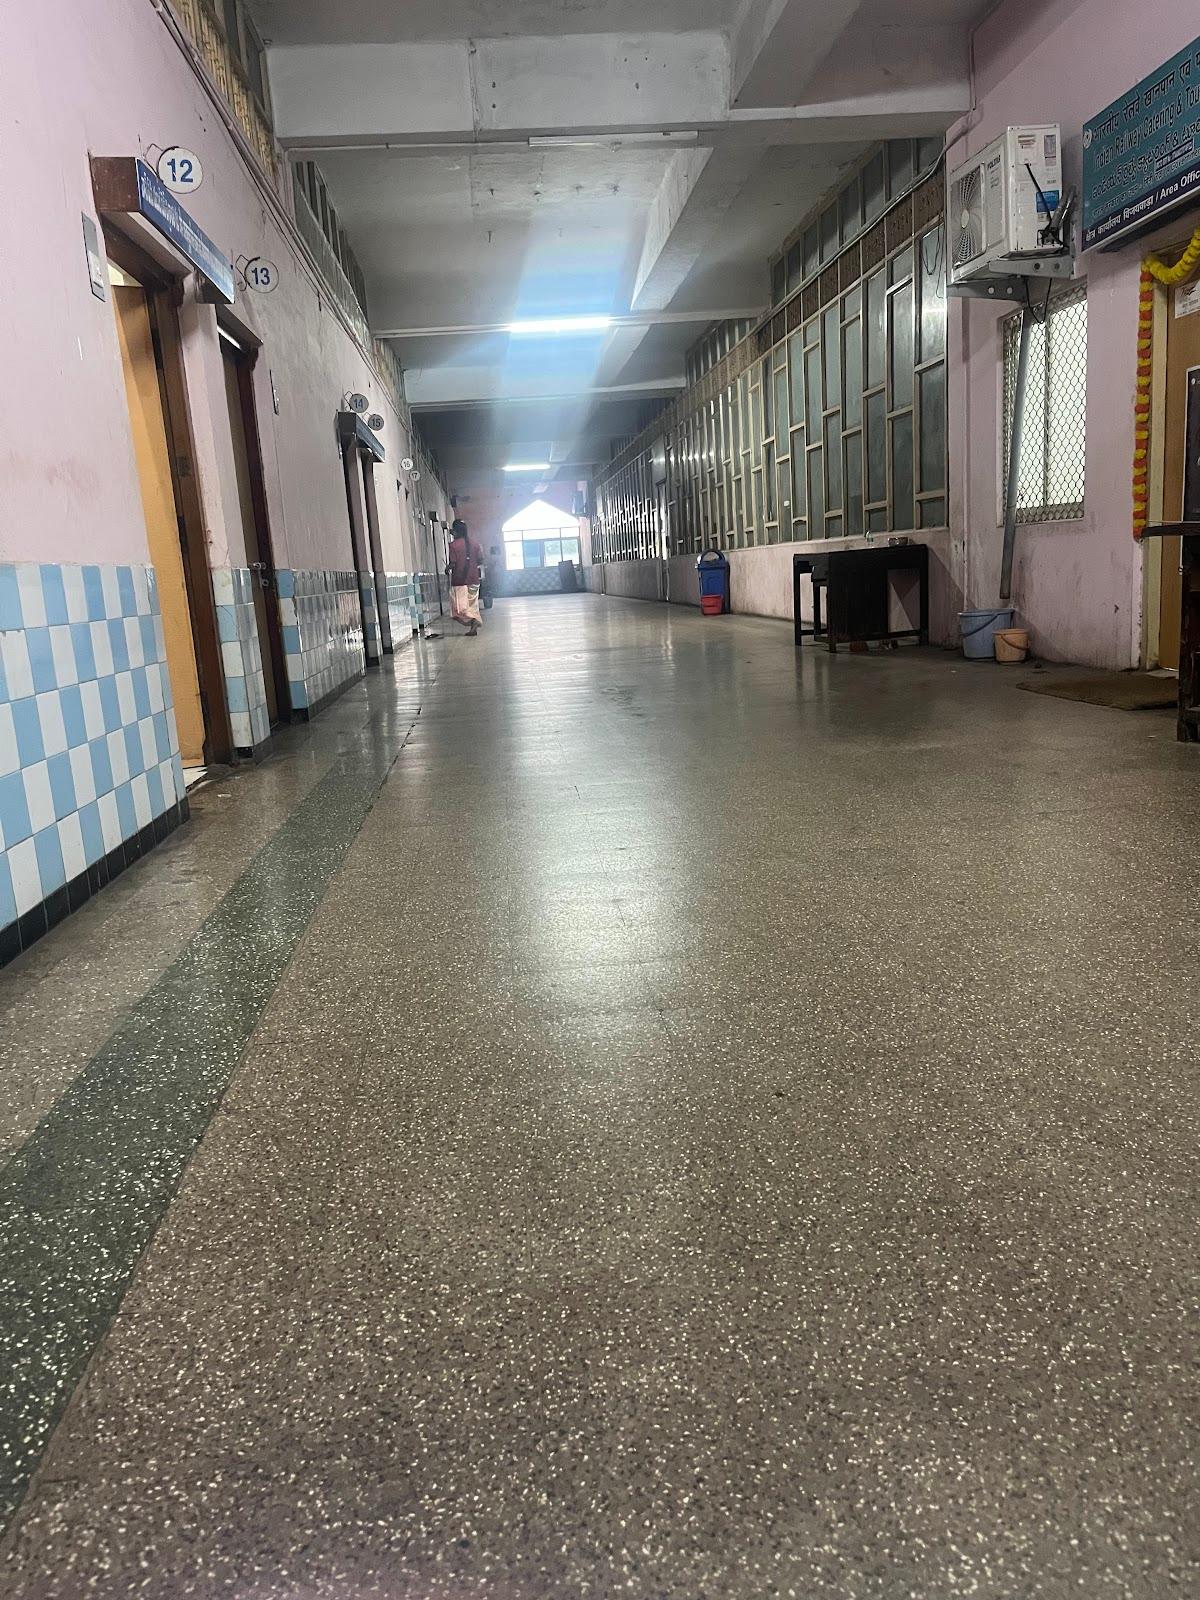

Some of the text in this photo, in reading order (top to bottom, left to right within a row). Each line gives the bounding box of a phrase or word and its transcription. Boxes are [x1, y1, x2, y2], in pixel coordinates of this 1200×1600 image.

[1143, 70, 1176, 108] खानपान
[1094, 144, 1116, 170] Indian
[1115, 126, 1142, 156] Railway
[1143, 103, 1175, 138] Catering
[1176, 92, 1183, 117] &
[166, 158, 194, 184] 12
[1097, 213, 1122, 235] कार्यालय
[1123, 195, 1154, 222] विजयवाड़ा
[1160, 182, 1179, 200] Area
[1180, 170, 1200, 188] Offic
[251, 267, 271, 286] 13
[353, 398, 363, 409] 14
[371, 418, 381, 428] 15
